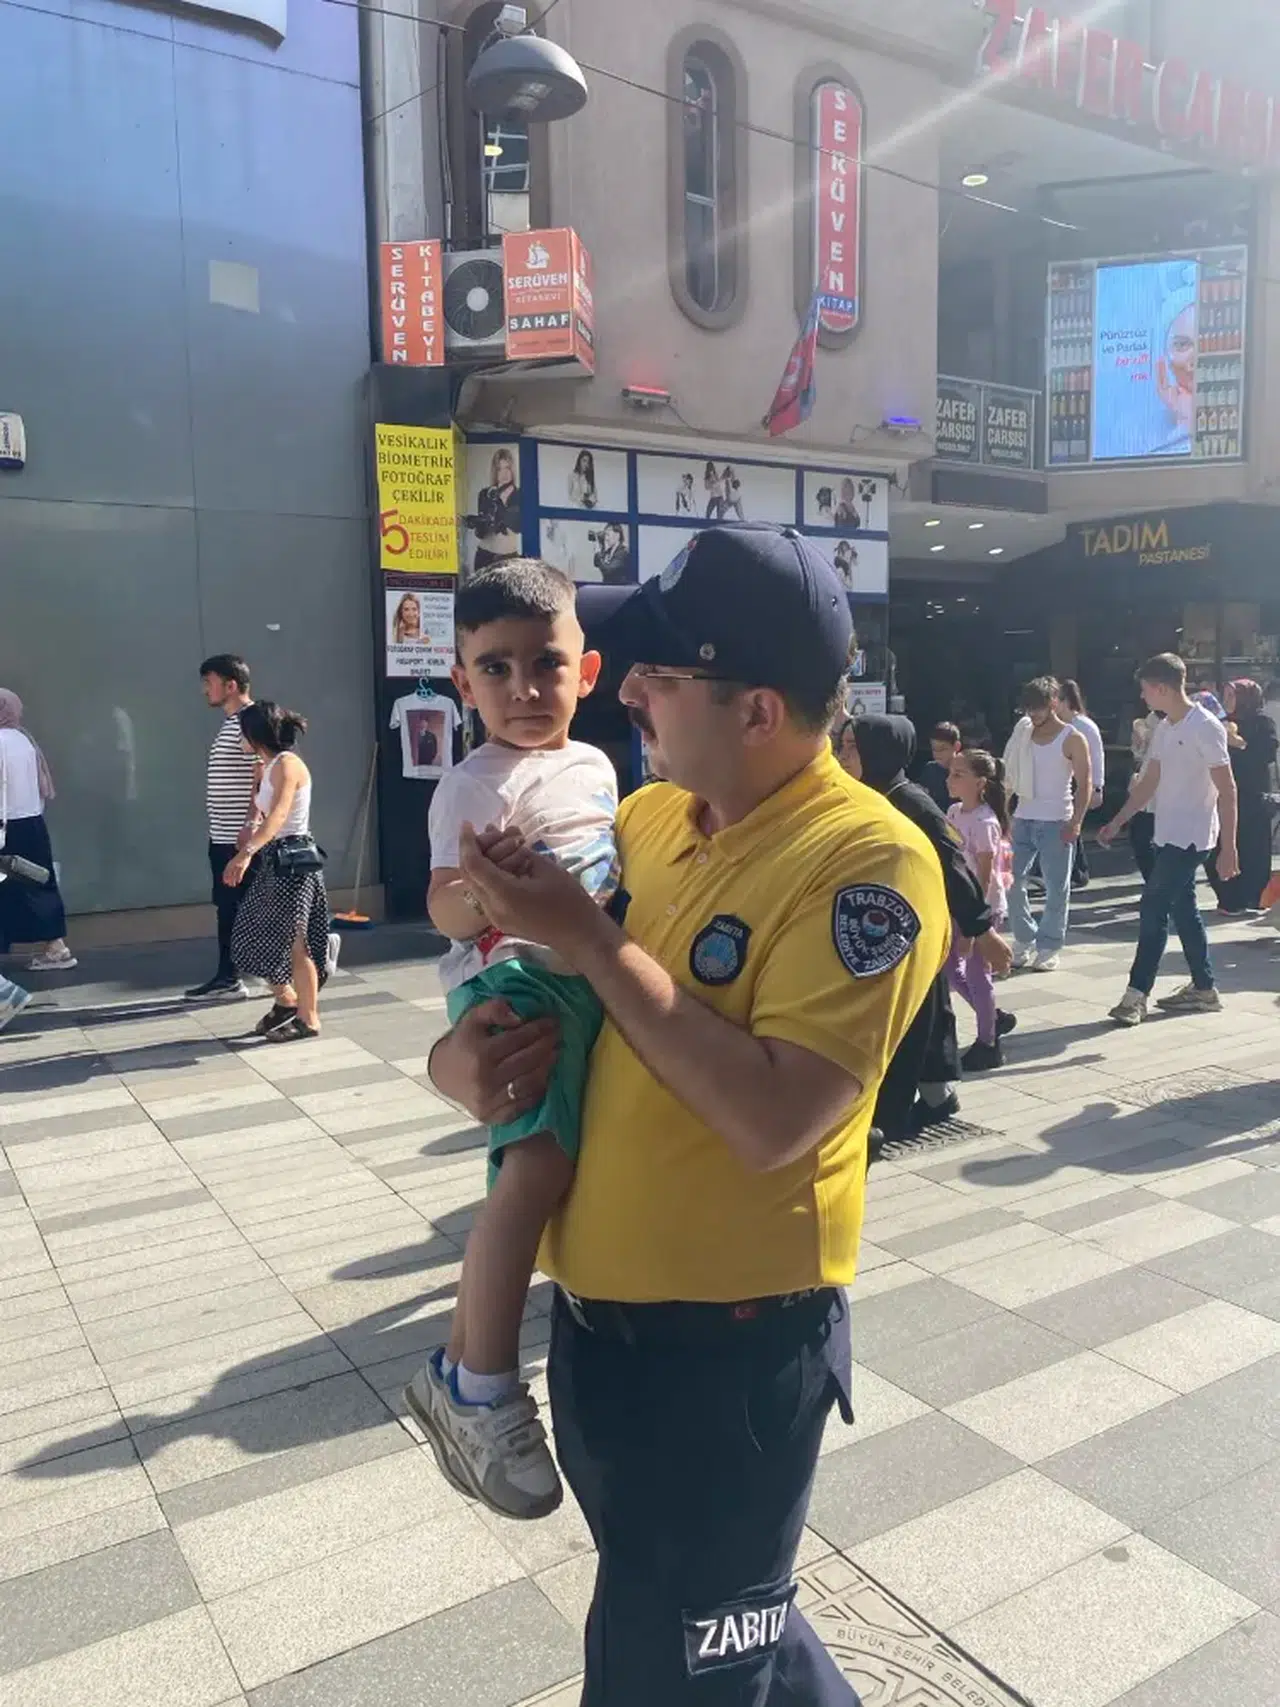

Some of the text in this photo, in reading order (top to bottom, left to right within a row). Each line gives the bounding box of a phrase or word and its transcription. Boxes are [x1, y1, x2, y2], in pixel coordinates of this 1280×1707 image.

[975, 0, 1143, 126] ZAFER
[830, 90, 847, 292] SERÜVEN
[508, 272, 568, 289] SERÜVEN
[391, 247, 407, 362] SERÜVEN
[419, 245, 434, 361] KİTABEVİ
[510, 314, 569, 330] SAHAF
[937, 399, 976, 423] ZAFER
[987, 405, 1027, 429] ZAFER
[378, 433, 448, 450] VESİKALIK
[378, 451, 453, 468] BİOMETRİK
[382, 470, 451, 486] FOTOĞRAF
[392, 489, 445, 504] ÇEKİLİR
[380, 509, 409, 555] 5
[1079, 518, 1168, 557] TADIM
[1138, 542, 1212, 567] PASTANESİ
[846, 892, 913, 927] TRABZON
[696, 1601, 787, 1658] ZABITA
[837, 1629, 886, 1650] BÜYÜK
[894, 1648, 936, 1671] ŞEHİR
